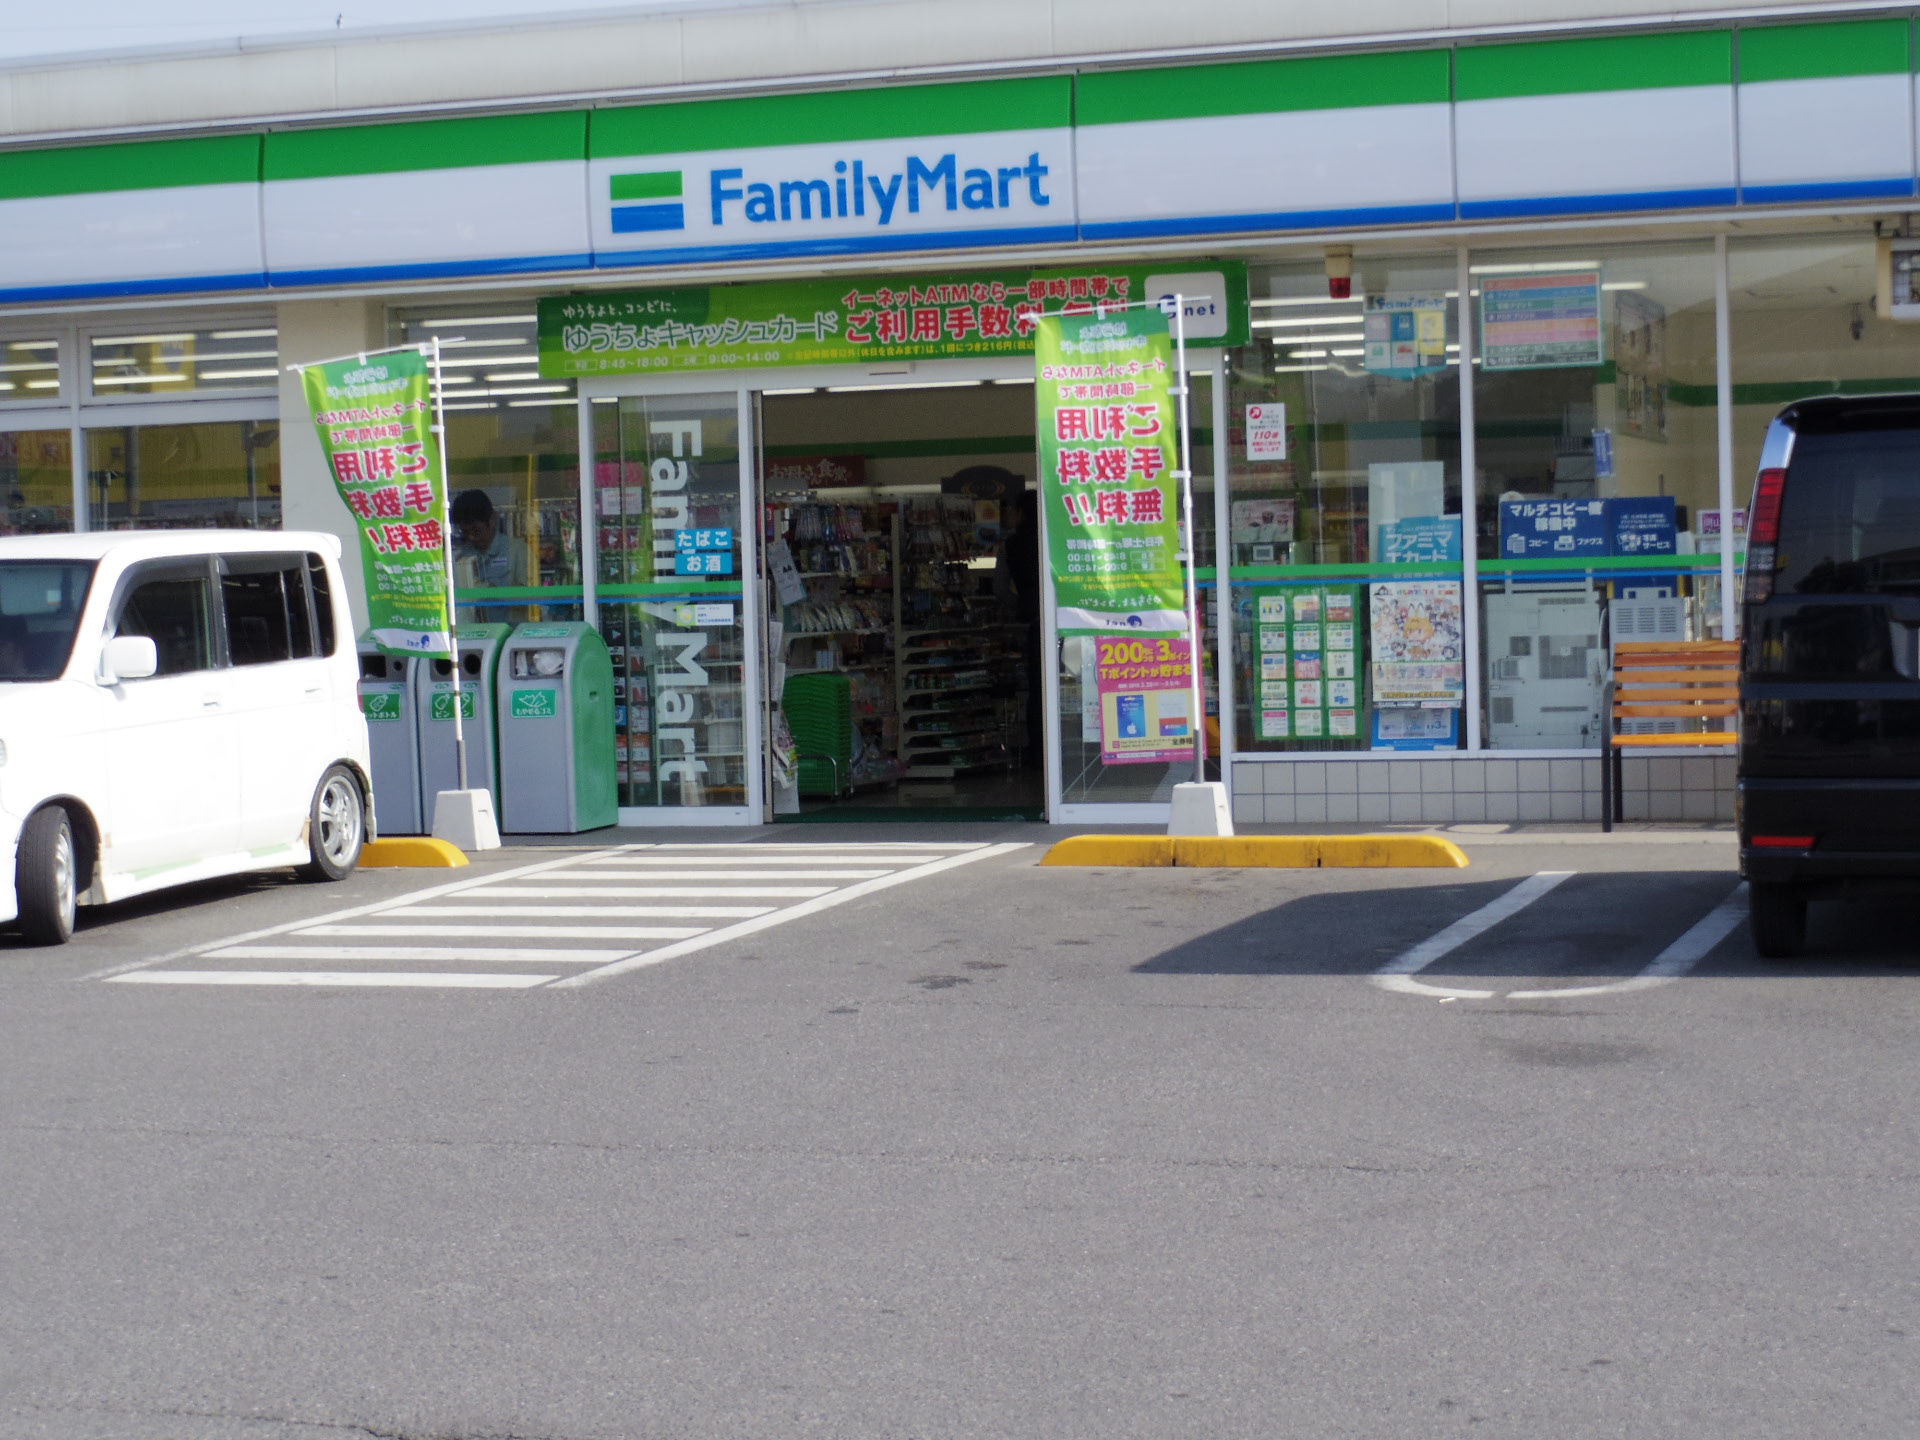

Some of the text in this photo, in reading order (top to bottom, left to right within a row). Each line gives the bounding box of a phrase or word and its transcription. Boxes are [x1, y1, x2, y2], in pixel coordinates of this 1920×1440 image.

[710, 151, 1050, 226] FamilyMart
[842, 276, 1131, 309] イーネットATMなら一部時間帯で
[1184, 302, 1217, 317] net
[562, 311, 839, 353] ゆうちょキャッシュカード
[677, 530, 729, 547] たばこ
[1385, 529, 1453, 551] ファミマ
[686, 553, 722, 572] お酒
[364, 710, 398, 720] ットボトル
